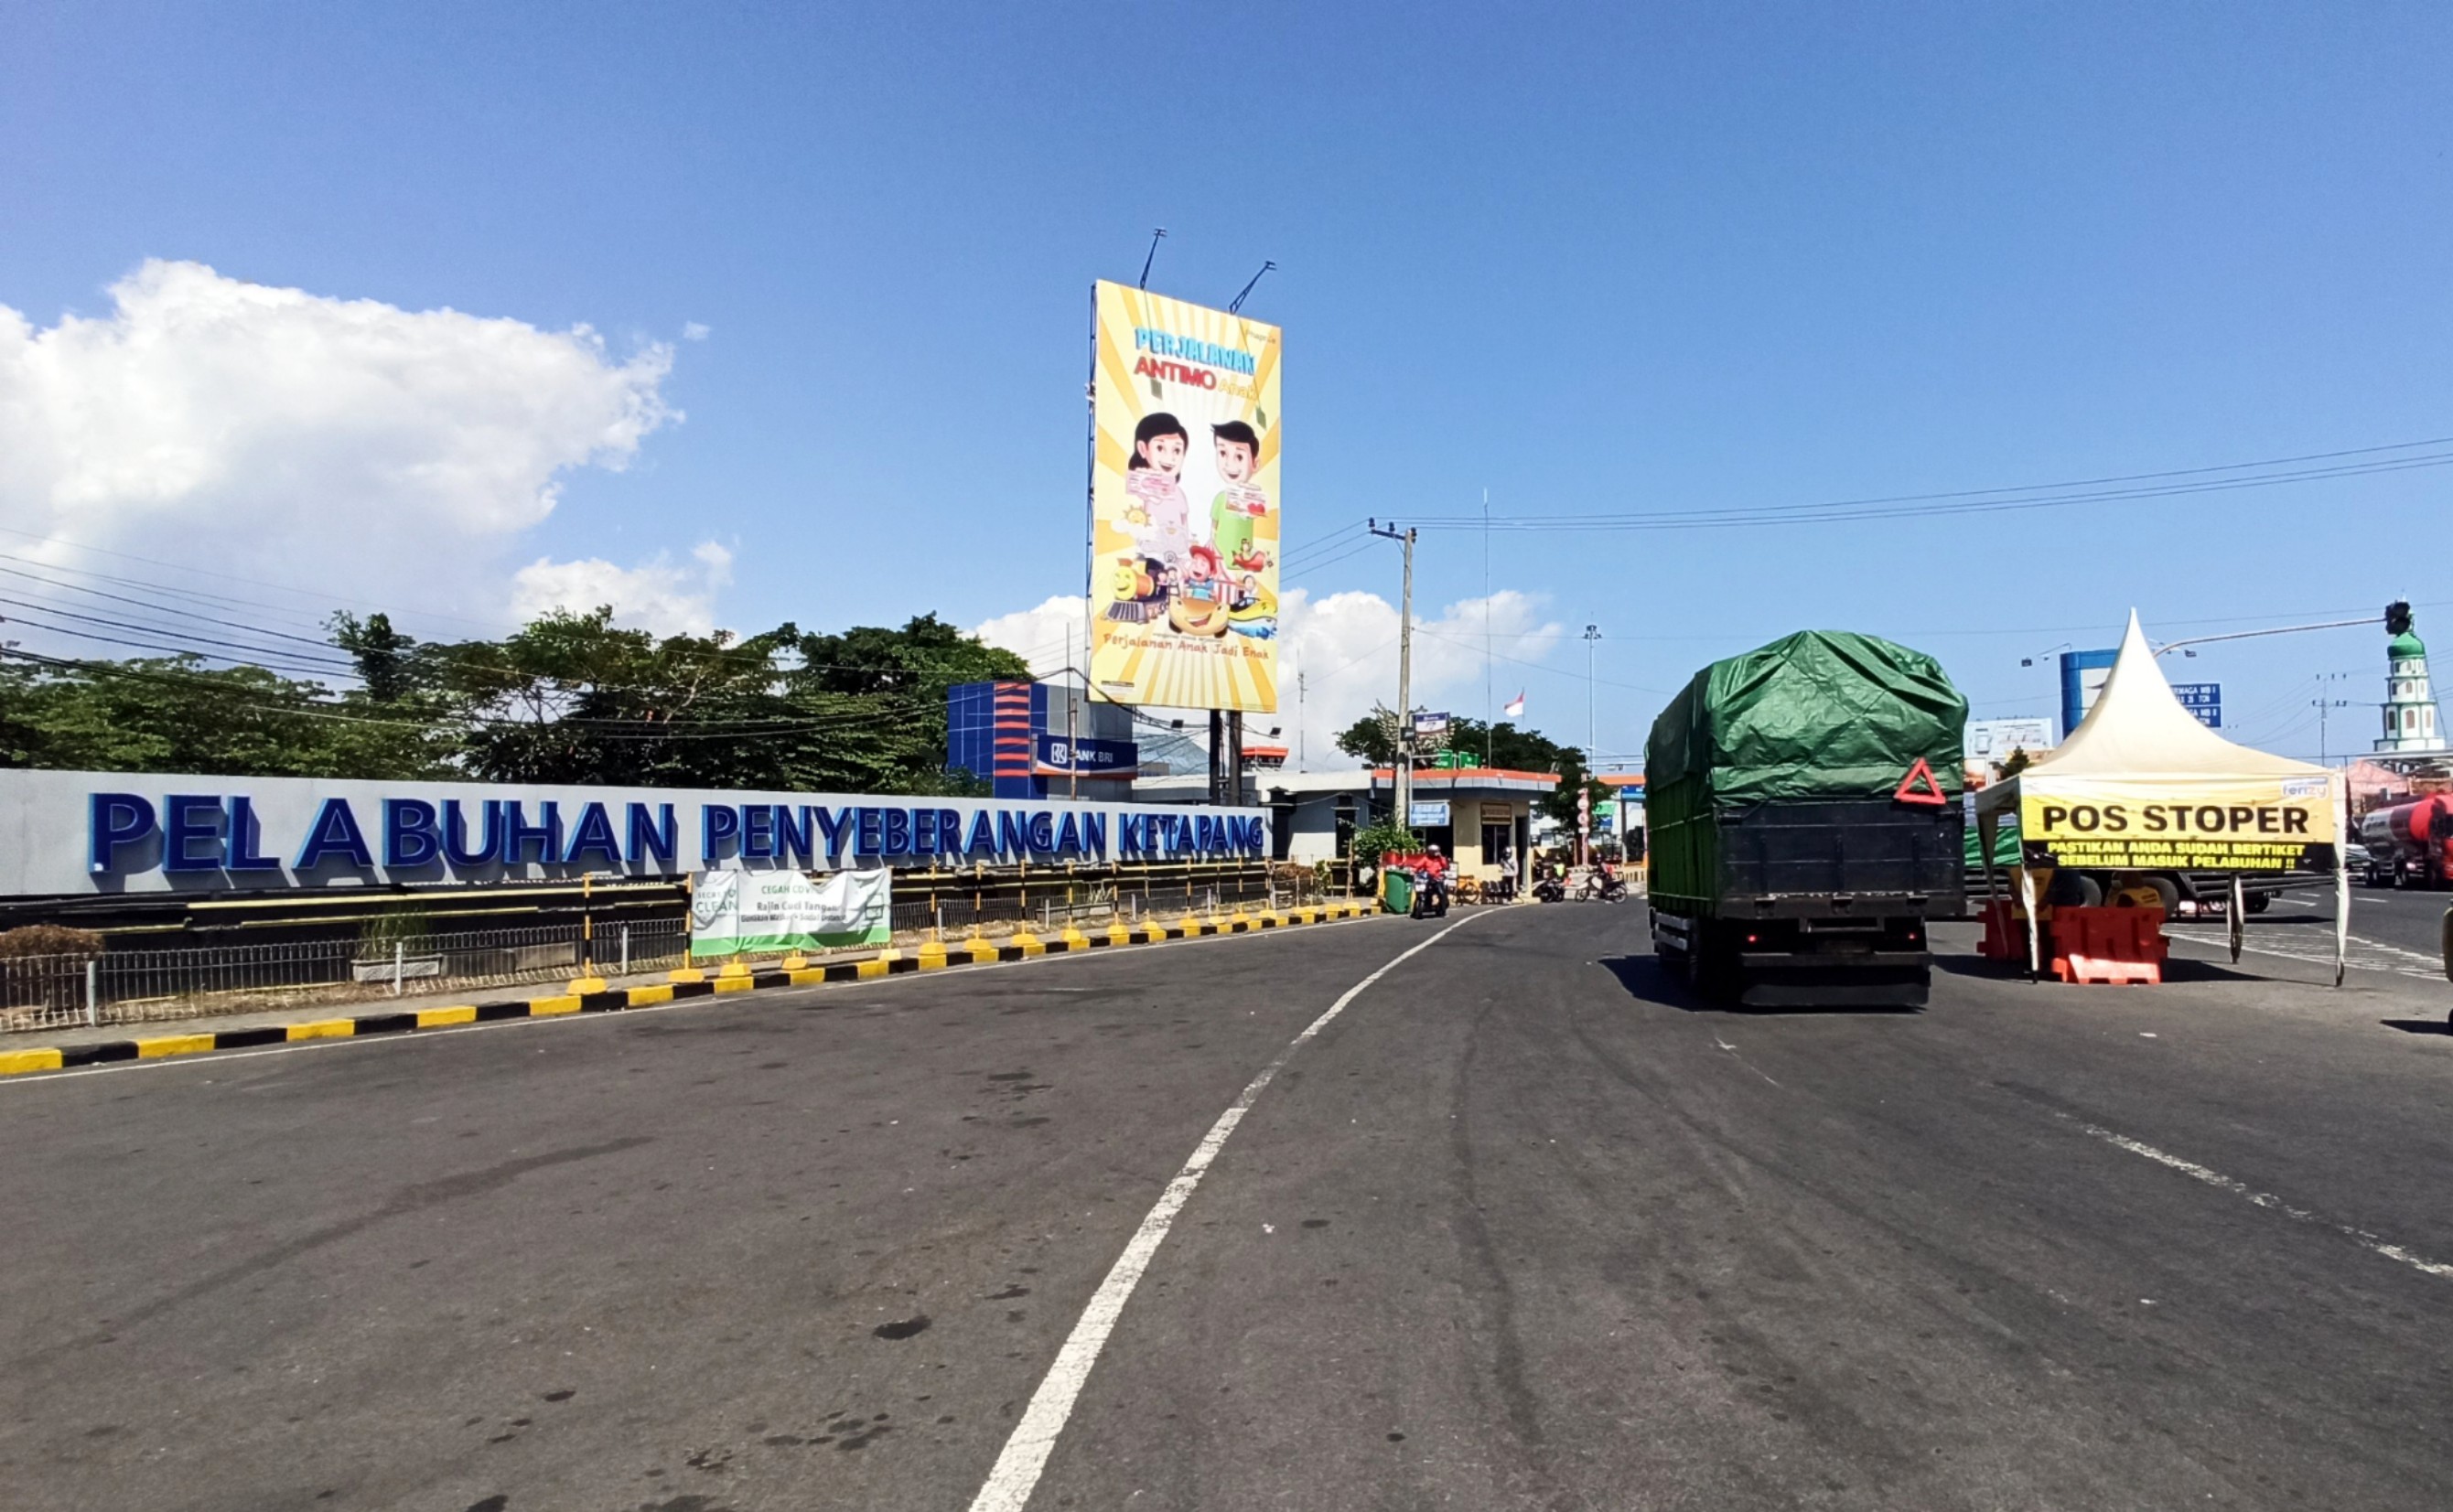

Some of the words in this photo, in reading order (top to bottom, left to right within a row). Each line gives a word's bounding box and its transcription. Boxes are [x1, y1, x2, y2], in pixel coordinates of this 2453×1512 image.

[1135, 327, 1255, 376] PERJALANAN
[1134, 356, 1218, 391] ANTIMO
[1218, 378, 1258, 401] Anak
[1103, 633, 1172, 649] Perjalanan
[1177, 640, 1208, 653] Anak
[1213, 643, 1238, 657] Jadi
[1243, 646, 1269, 659] Enak
[1069, 750, 1096, 763] ANK
[1098, 751, 1114, 763] BRI
[2042, 805, 2128, 832] POS
[2142, 805, 2308, 834] STOPER
[89, 793, 674, 873] PELABUHAN
[701, 805, 1106, 860] PENYEBERANGAN
[1119, 813, 1264, 852] KETAPANG
[2048, 842, 2125, 853] PASTIKAN
[2128, 842, 2172, 853] ANDA
[2176, 842, 2229, 854] SUDAH
[2232, 844, 2305, 856] BERTIKET
[2058, 854, 2128, 866] SEBELUM
[2133, 855, 2189, 867] MASUK
[2193, 856, 2282, 868] PELABUHAN
[761, 885, 791, 895] CEGAH
[696, 901, 737, 913] CLEAN
[757, 902, 780, 913] Rajin
[782, 901, 802, 911] Cuci
